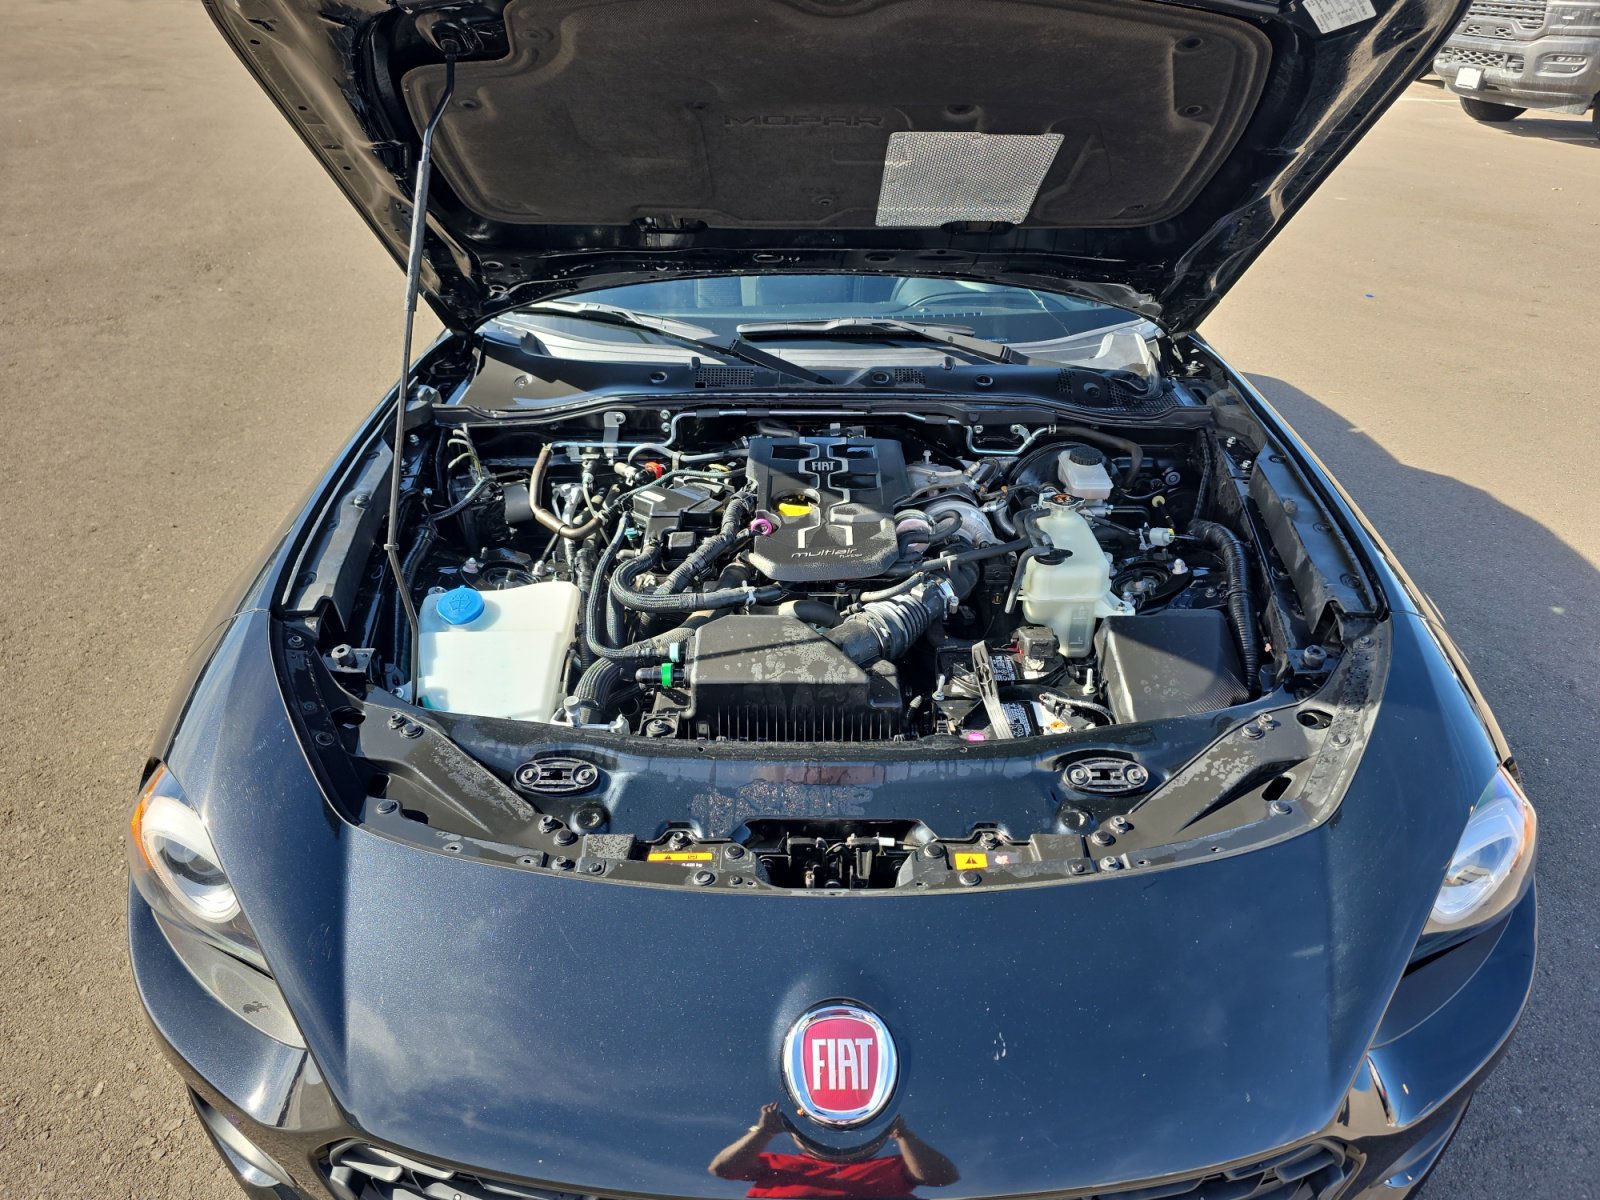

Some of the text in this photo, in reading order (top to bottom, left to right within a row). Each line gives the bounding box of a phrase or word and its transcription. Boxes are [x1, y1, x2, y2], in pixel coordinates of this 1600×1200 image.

[723, 115, 883, 127] MOPAR
[811, 461, 836, 471] FIAT
[811, 1038, 873, 1091] FIAT
